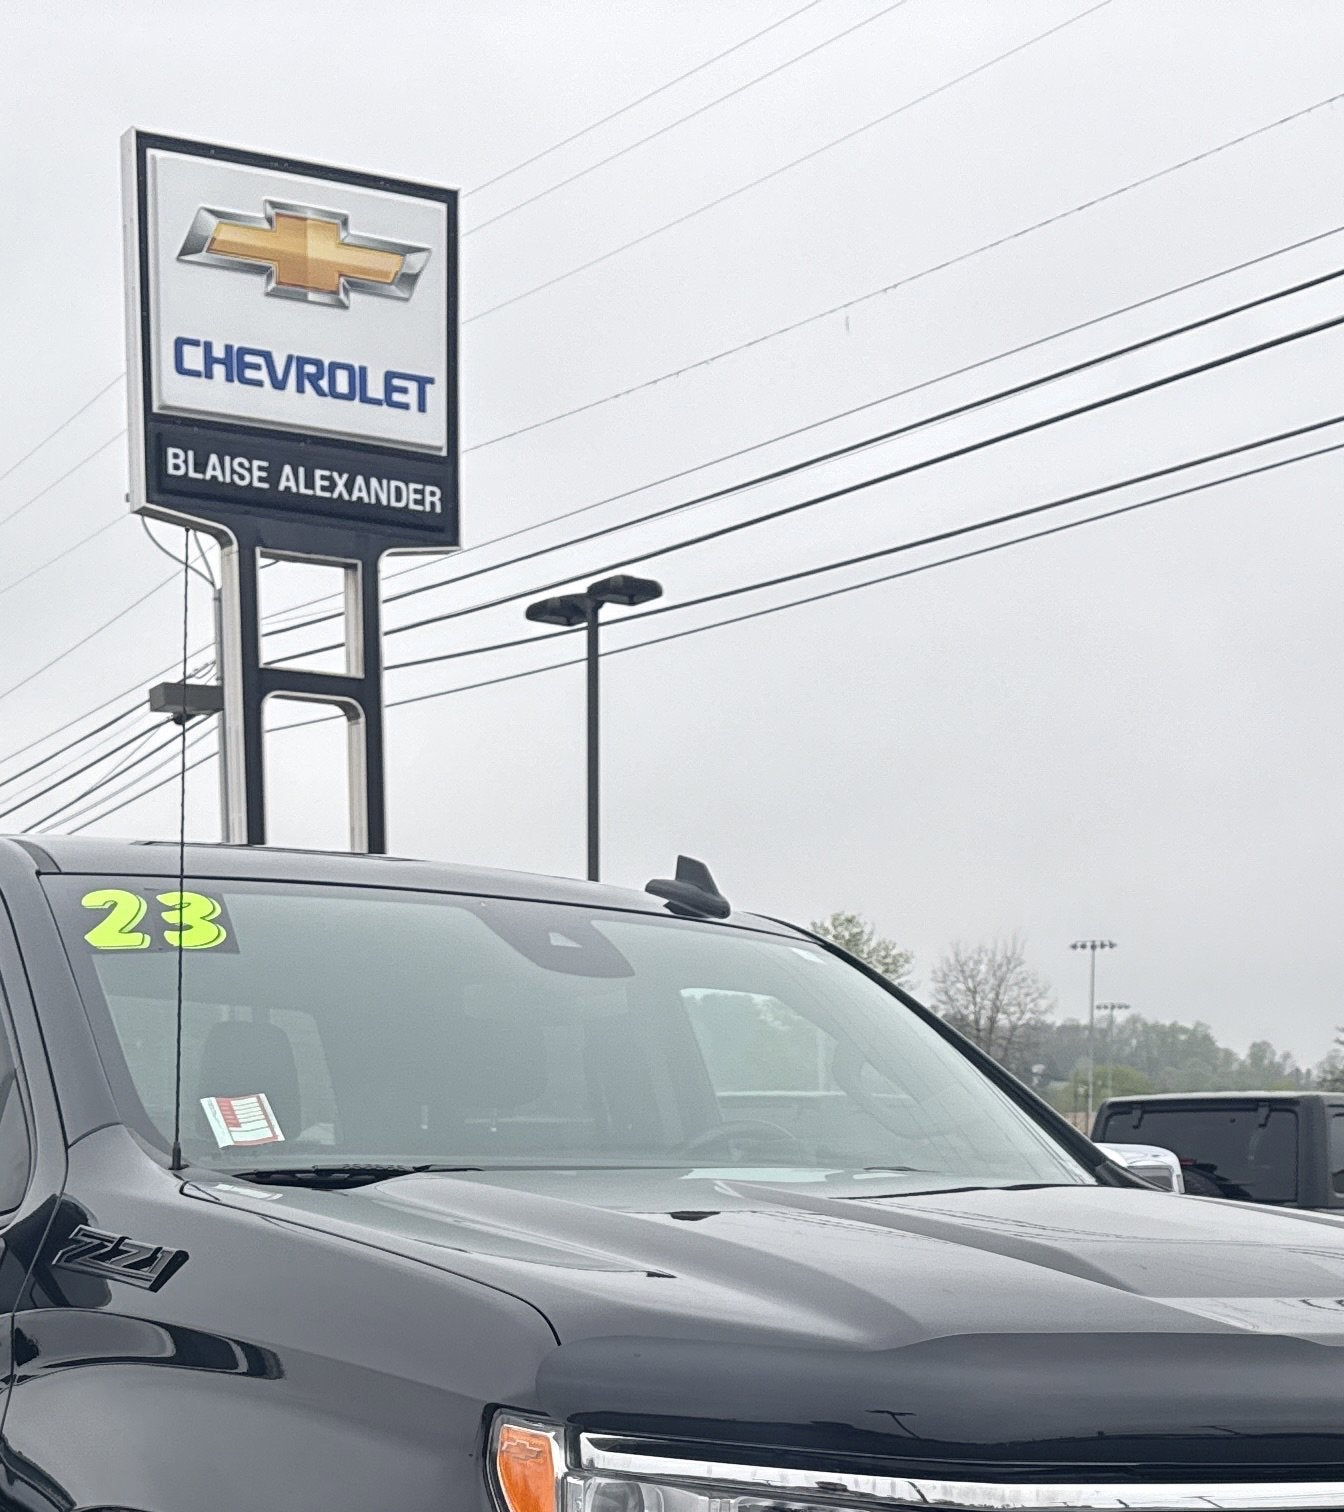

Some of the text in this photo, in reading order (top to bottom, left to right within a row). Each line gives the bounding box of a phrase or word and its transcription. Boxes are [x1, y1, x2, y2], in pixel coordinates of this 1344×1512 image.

[174, 336, 435, 413] CHEVROLET
[166, 447, 443, 514] BLAISE ALEXANDER
[81, 889, 227, 950] 23
[52, 1224, 177, 1288] Z71
